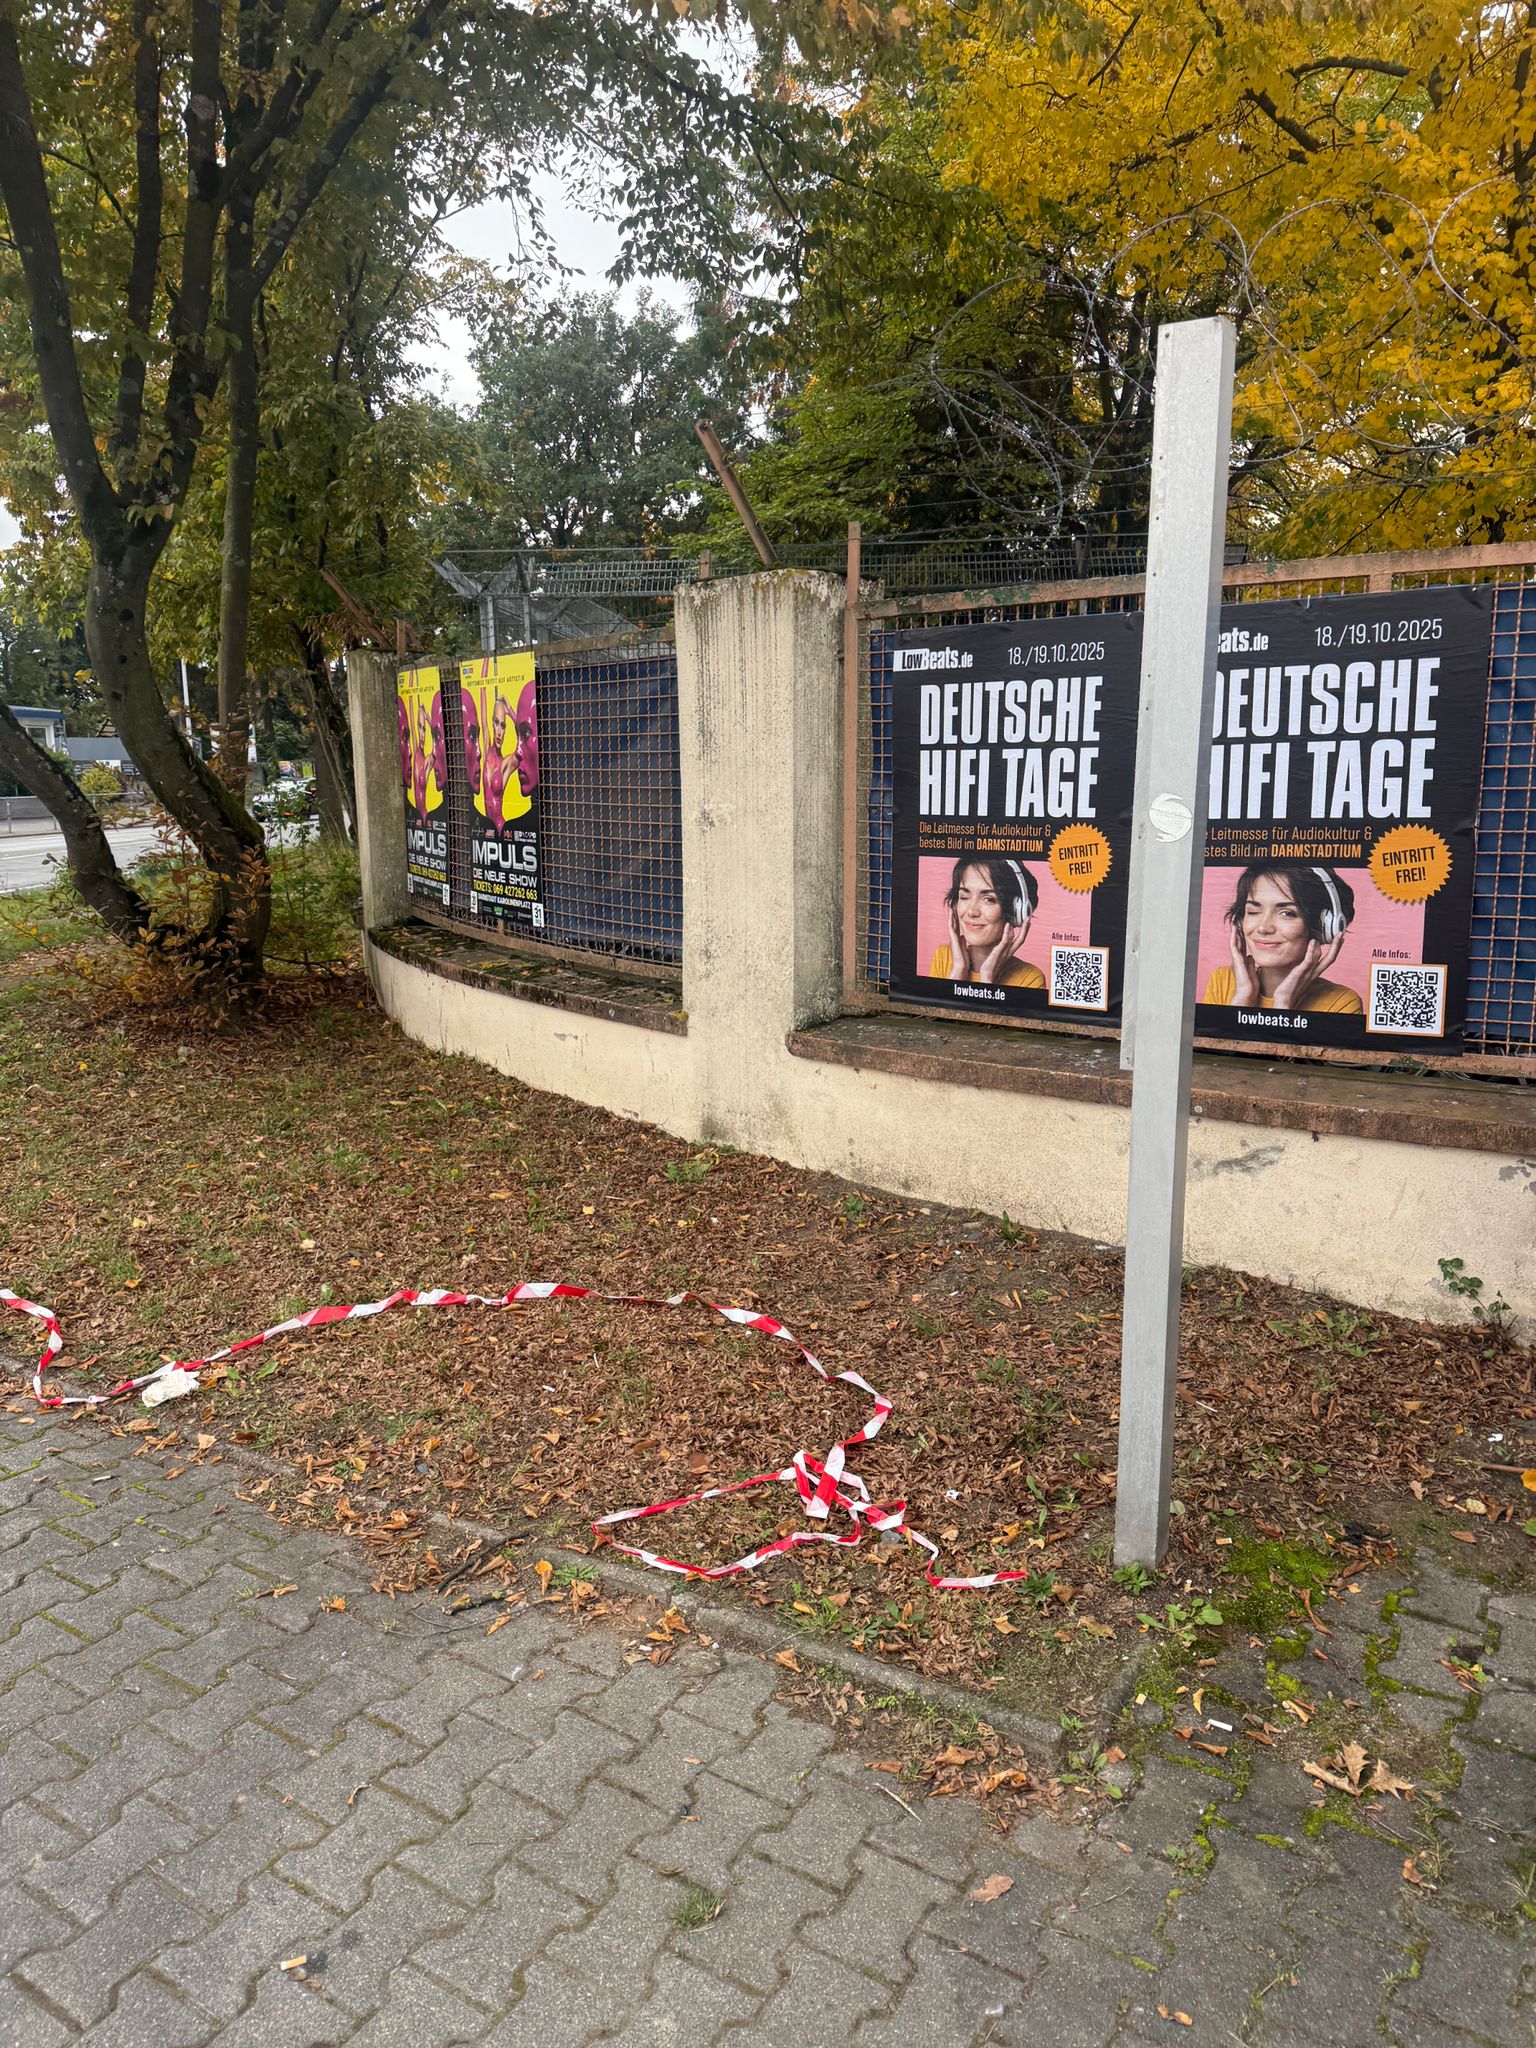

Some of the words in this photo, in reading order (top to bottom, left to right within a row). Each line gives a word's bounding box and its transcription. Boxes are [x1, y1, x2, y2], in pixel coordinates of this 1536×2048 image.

[1217, 627, 1269, 653] ats.de
[1315, 618, 1443, 648] 18./19.10.2025
[901, 647, 973, 670] LowBeats.de
[1007, 641, 1105, 667] 18./19.10.2025
[919, 675, 1103, 745] DEUTSCHE
[919, 749, 991, 817] HIFI
[1002, 747, 1100, 818] TAGE
[1307, 737, 1436, 820] TAGE
[919, 821, 931, 834] Die
[933, 822, 975, 835] Leitmesse
[977, 822, 989, 835] für
[991, 823, 1042, 837] Audiokultur
[1044, 824, 1052, 837] &
[1211, 826, 1269, 841] Leitmesse
[1271, 826, 1289, 841] für
[1291, 826, 1361, 841] Audiokultur
[1364, 825, 1372, 841] &
[407, 828, 446, 857] IMPULS
[919, 836, 946, 849] bestes
[947, 836, 963, 850] Bild
[964, 838, 975, 850] im
[976, 838, 1044, 852] DARMSTADTIUM
[1058, 843, 1099, 861] EINTRITT
[1204, 845, 1227, 858] stes
[1230, 843, 1251, 857] Bild
[1254, 844, 1268, 857] im
[1271, 843, 1362, 858] DARMSTADTIUM
[472, 839, 538, 872] IMPULS
[1382, 845, 1436, 867] EINTRITT
[473, 867, 483, 879] DIE
[484, 869, 506, 883] NEUE
[508, 873, 538, 888] SHOW
[1068, 861, 1093, 876] FREI!
[1396, 868, 1427, 885] FREI!
[1051, 932, 1063, 941] Alle
[1064, 932, 1082, 942] Infos:
[1372, 948, 1387, 959] Alle
[1388, 949, 1411, 960] Infos:
[953, 983, 1006, 1001] lowbeats.de
[1237, 1010, 1308, 1029] lowbeats.de
